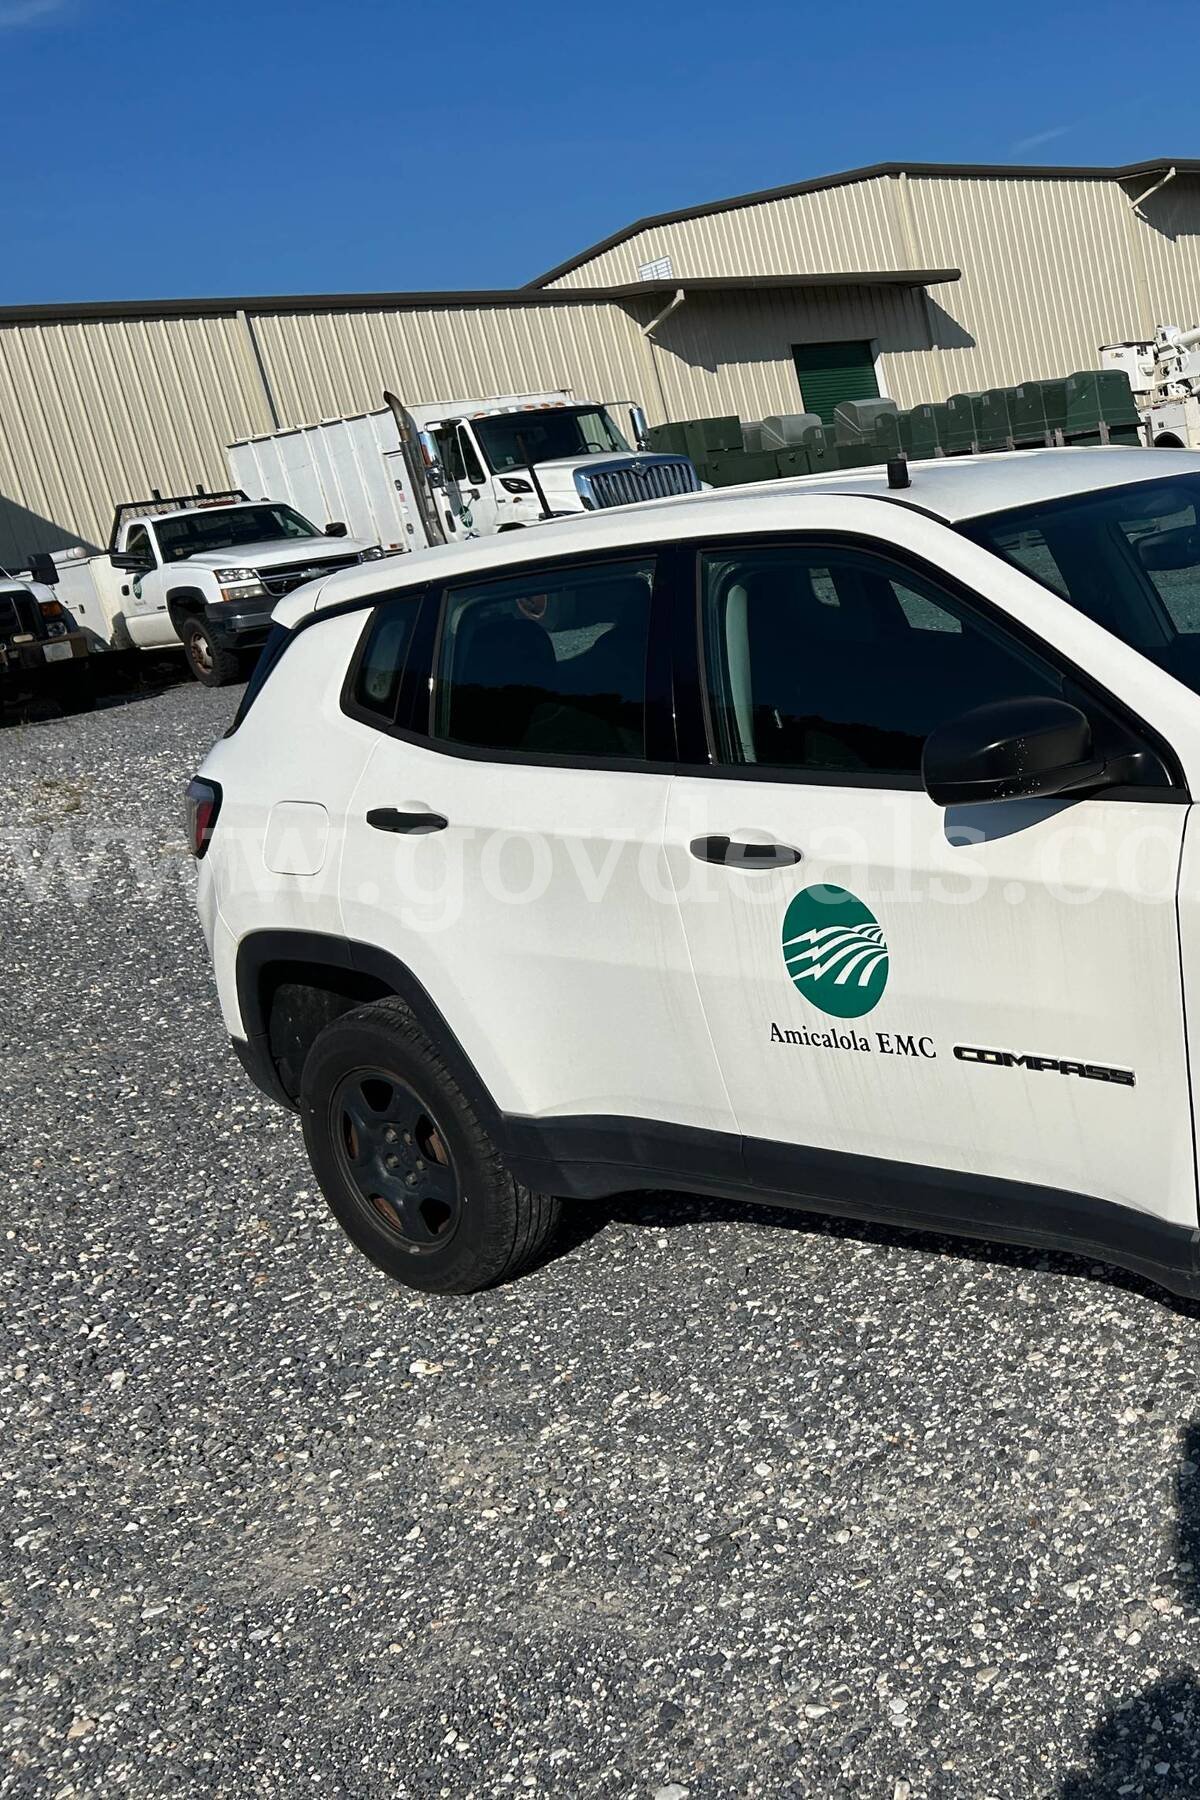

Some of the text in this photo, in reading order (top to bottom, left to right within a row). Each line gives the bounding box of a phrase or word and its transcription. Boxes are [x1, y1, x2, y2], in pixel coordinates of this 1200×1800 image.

[769, 1022, 937, 1058] Amicalola EMC
[952, 1045, 1136, 1088] COMPASS
